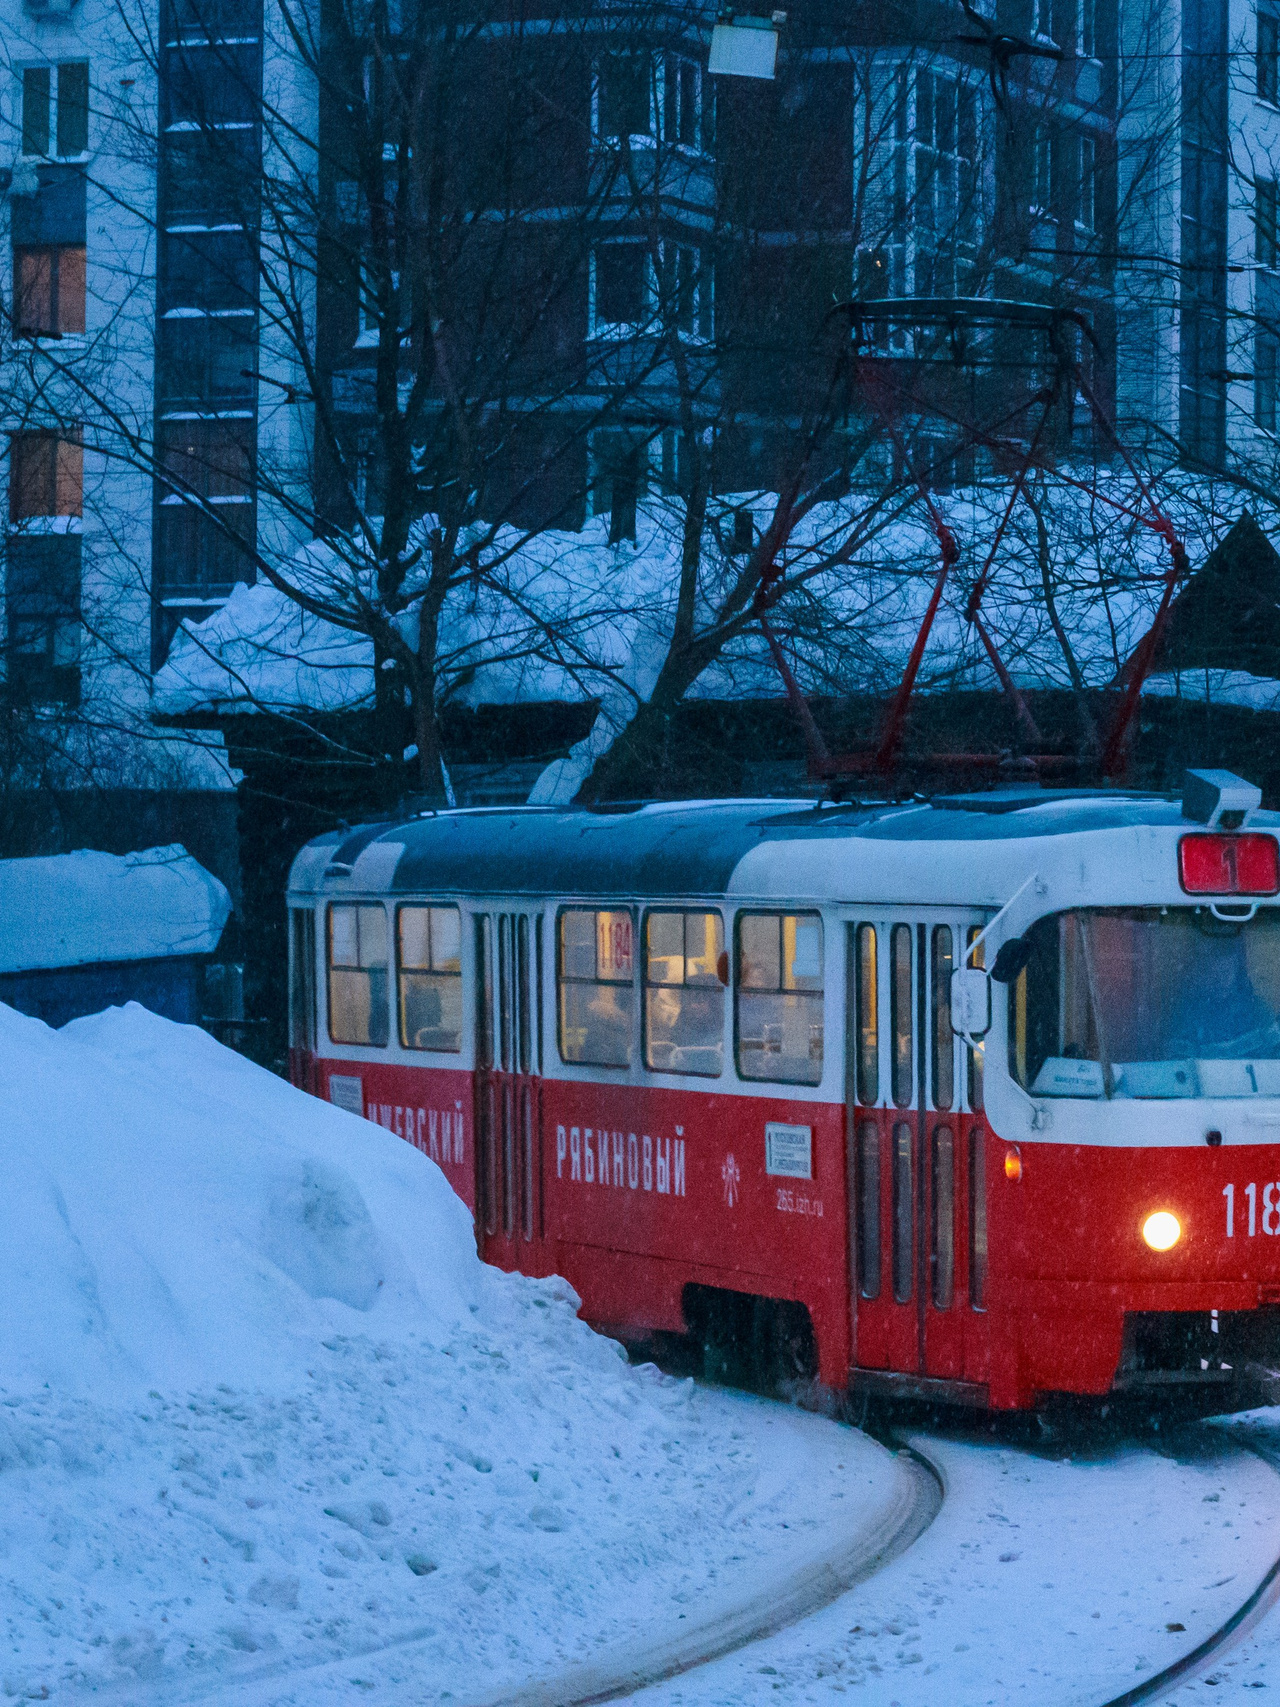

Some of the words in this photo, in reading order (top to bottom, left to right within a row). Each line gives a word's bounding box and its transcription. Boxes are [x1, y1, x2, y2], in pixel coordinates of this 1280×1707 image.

[1222, 845, 1238, 891] 1
[1245, 1064, 1258, 1093] 1
[556, 1124, 686, 1197] РЯБИНОВЫЙ
